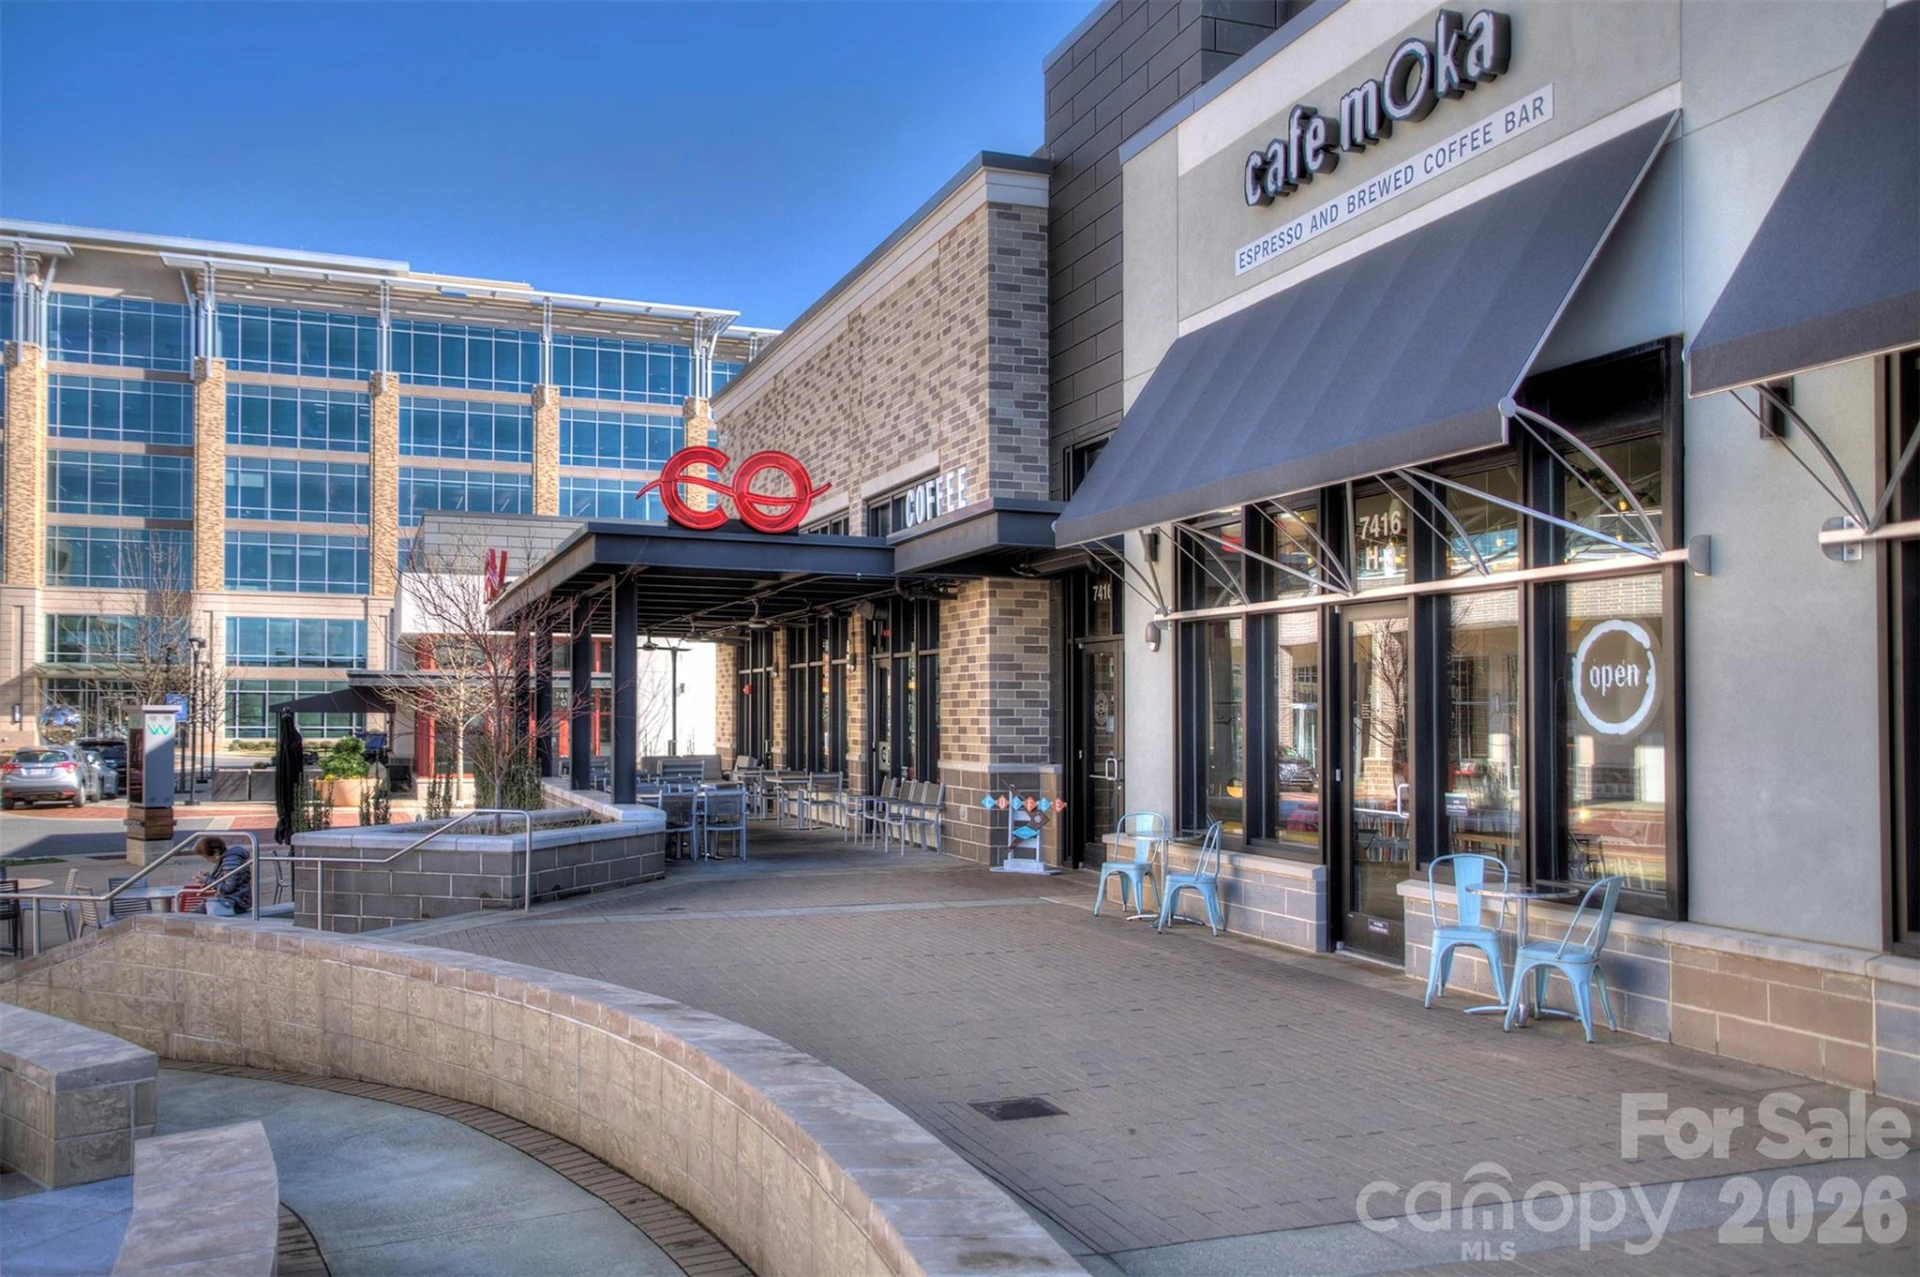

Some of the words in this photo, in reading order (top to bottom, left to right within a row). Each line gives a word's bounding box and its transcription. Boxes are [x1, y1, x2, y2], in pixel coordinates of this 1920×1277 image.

[1238, 222, 1304, 270] ESPRESSO
[1309, 204, 1339, 234] AND
[1347, 164, 1415, 214] BREWED
[1423, 121, 1494, 174] COFFEE
[1504, 96, 1545, 134] BAR
[1245, 104, 1339, 207] cafe
[905, 466, 971, 528] COFFEE
[1359, 510, 1402, 540] 7416
[1589, 662, 1640, 697] open
